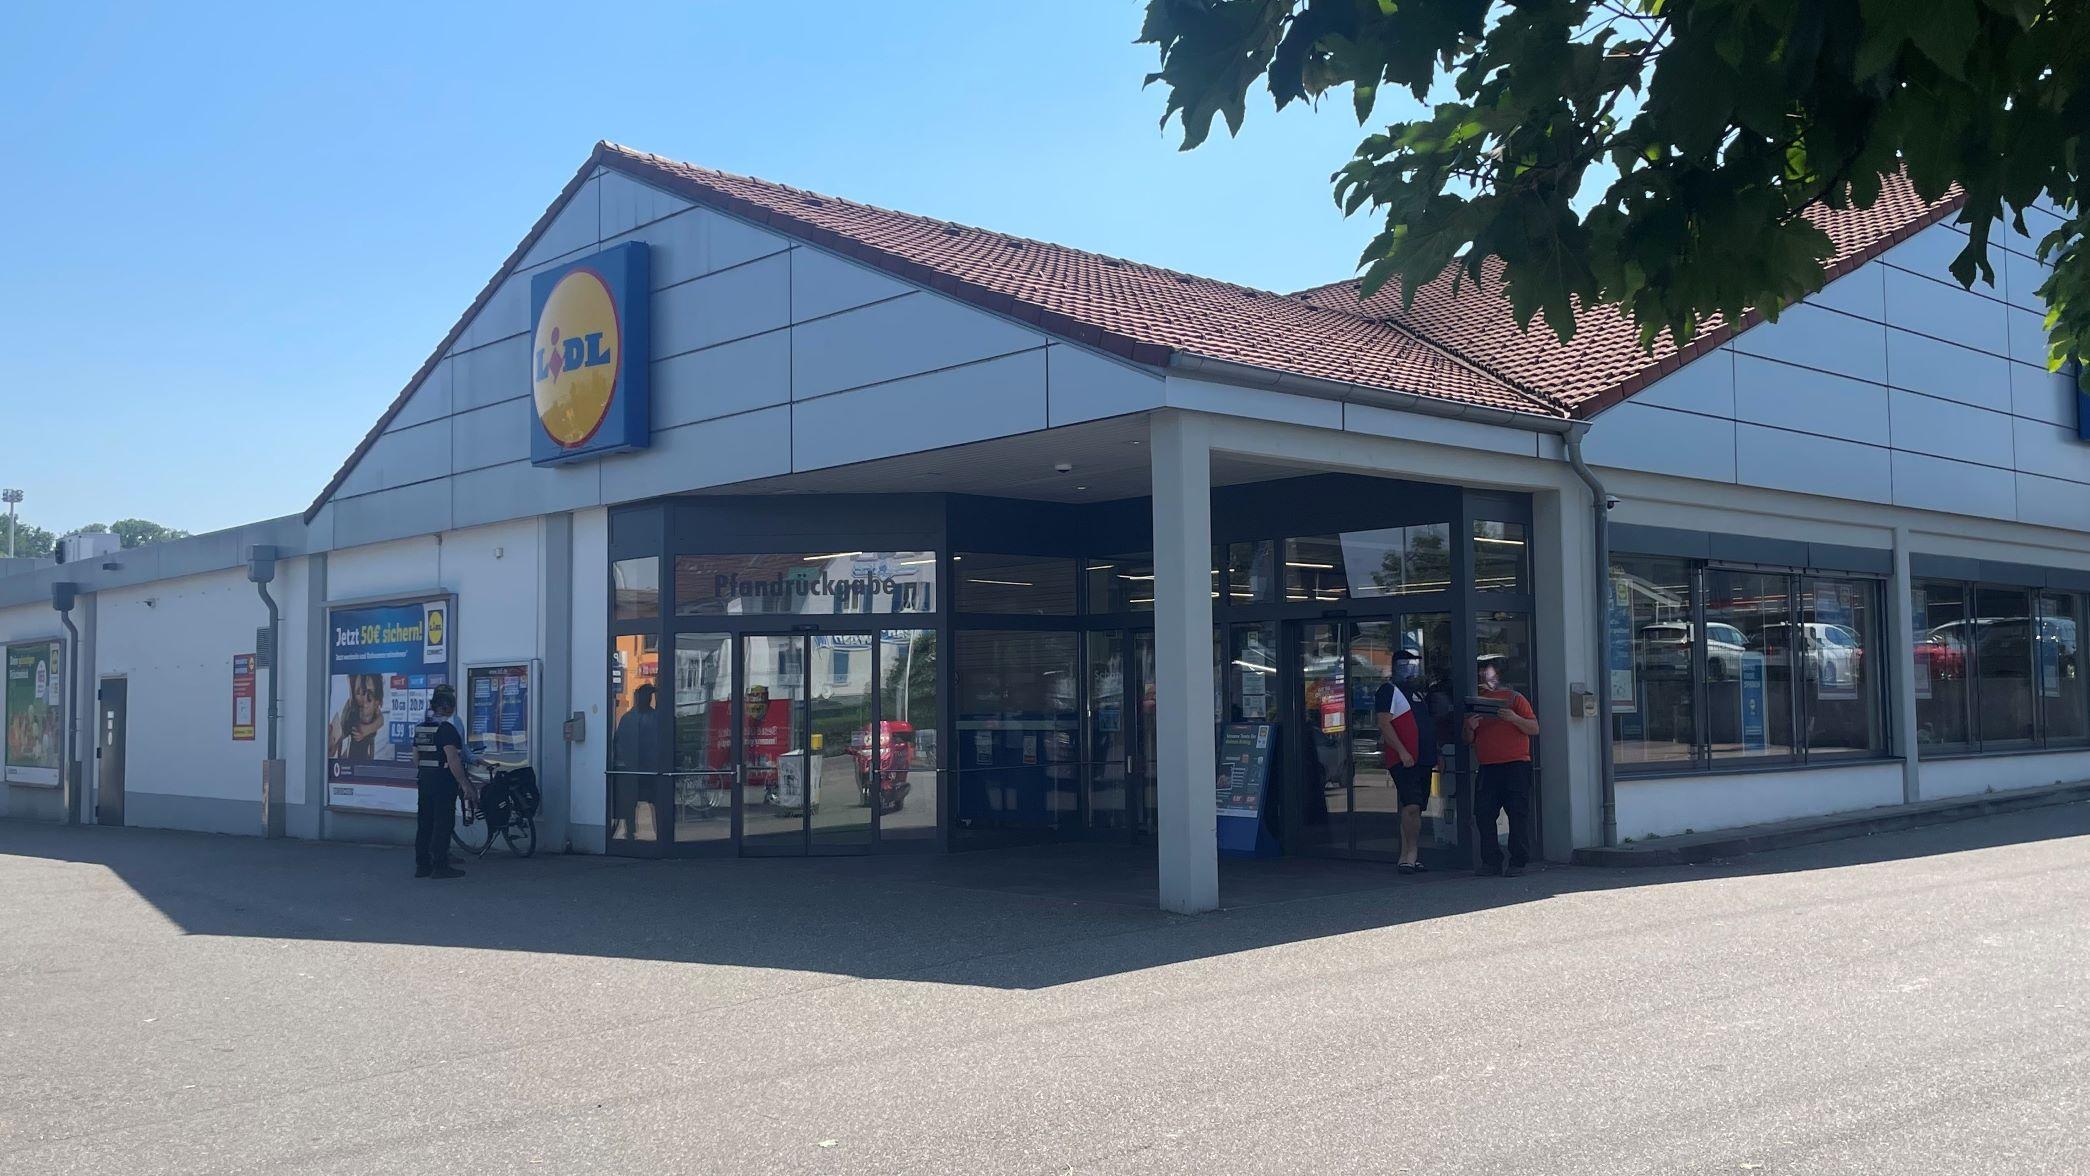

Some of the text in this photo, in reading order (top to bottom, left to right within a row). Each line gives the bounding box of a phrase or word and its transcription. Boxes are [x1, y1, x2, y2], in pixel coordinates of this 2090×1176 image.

[536, 327, 611, 384] LIDL
[714, 570, 896, 604] Pfandrückgabe
[336, 621, 423, 647] Jetzt 50€ sichern!
[392, 699, 399, 711] 10
